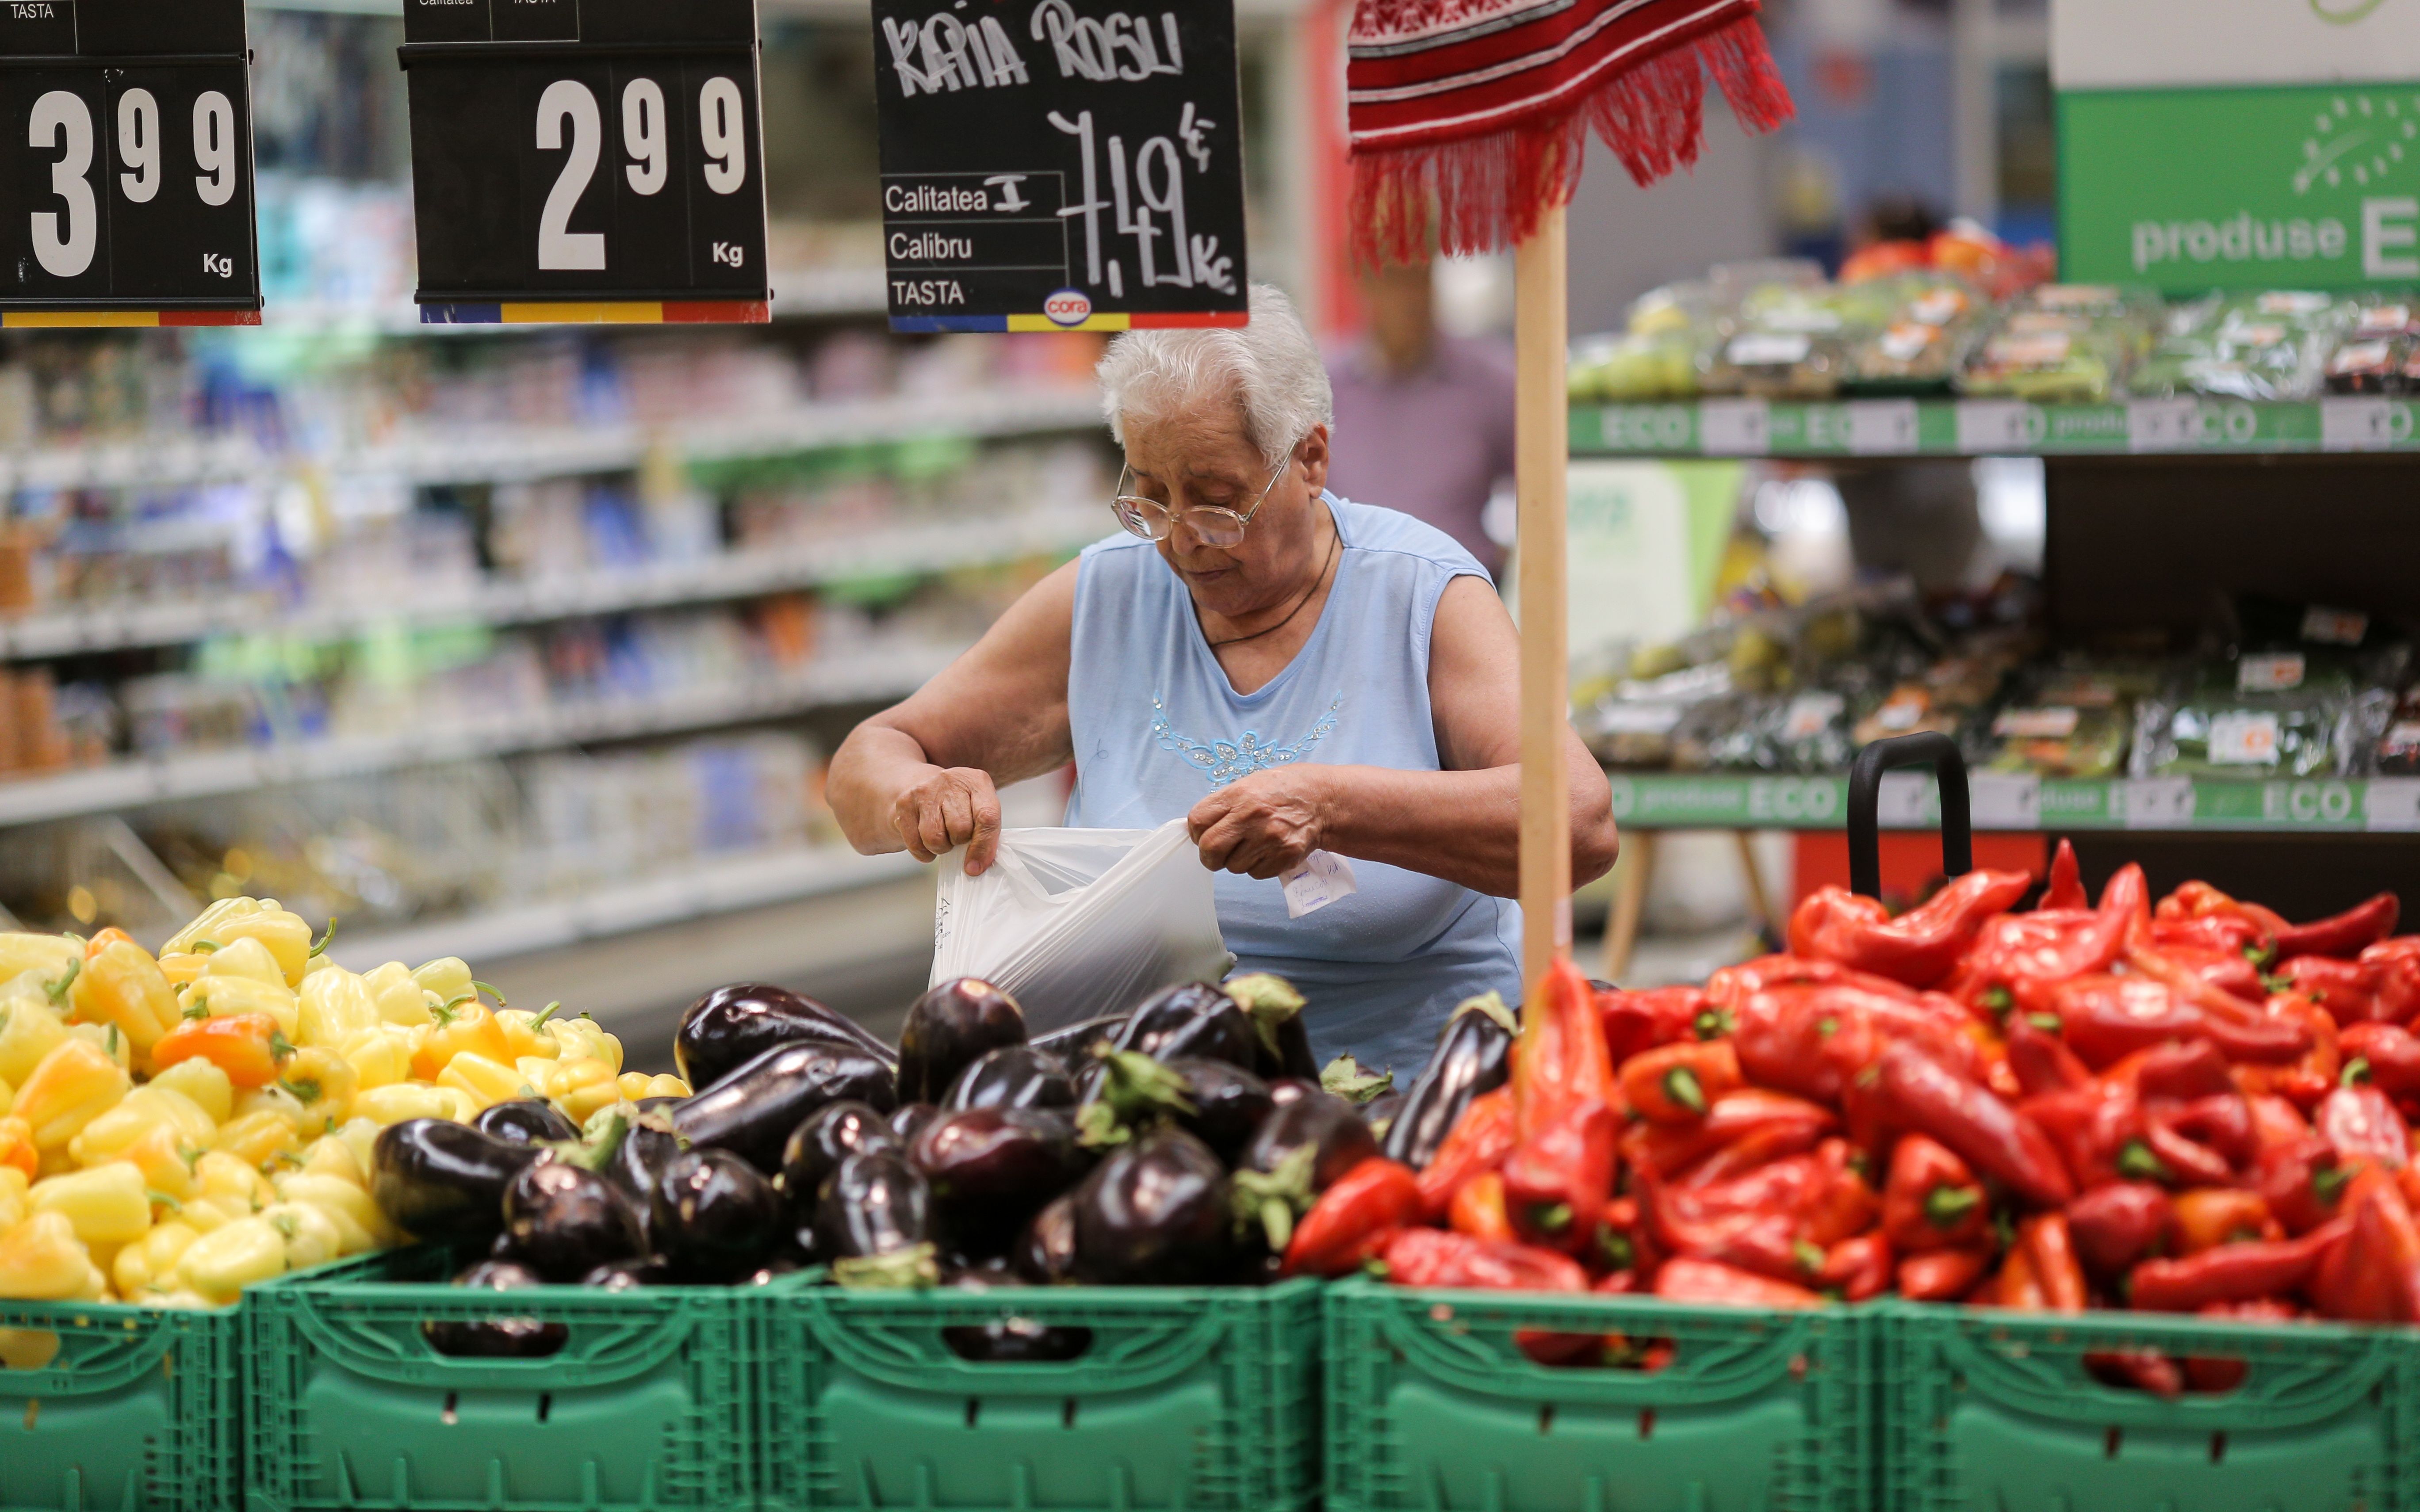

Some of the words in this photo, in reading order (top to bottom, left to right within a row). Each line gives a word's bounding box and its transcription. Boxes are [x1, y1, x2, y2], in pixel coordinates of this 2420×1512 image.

[11, 4, 54, 18] TASTA
[885, 185, 988, 212] Calitatea
[713, 242, 743, 267] Kg
[890, 233, 972, 259] Calibru
[2132, 210, 2347, 274] produse
[203, 253, 232, 278] Kg
[892, 281, 965, 305] TASTA
[1048, 301, 1087, 313] cora
[1602, 404, 1690, 447] ECO
[1749, 776, 1837, 819] ECO
[2262, 779, 2352, 822] ECO
